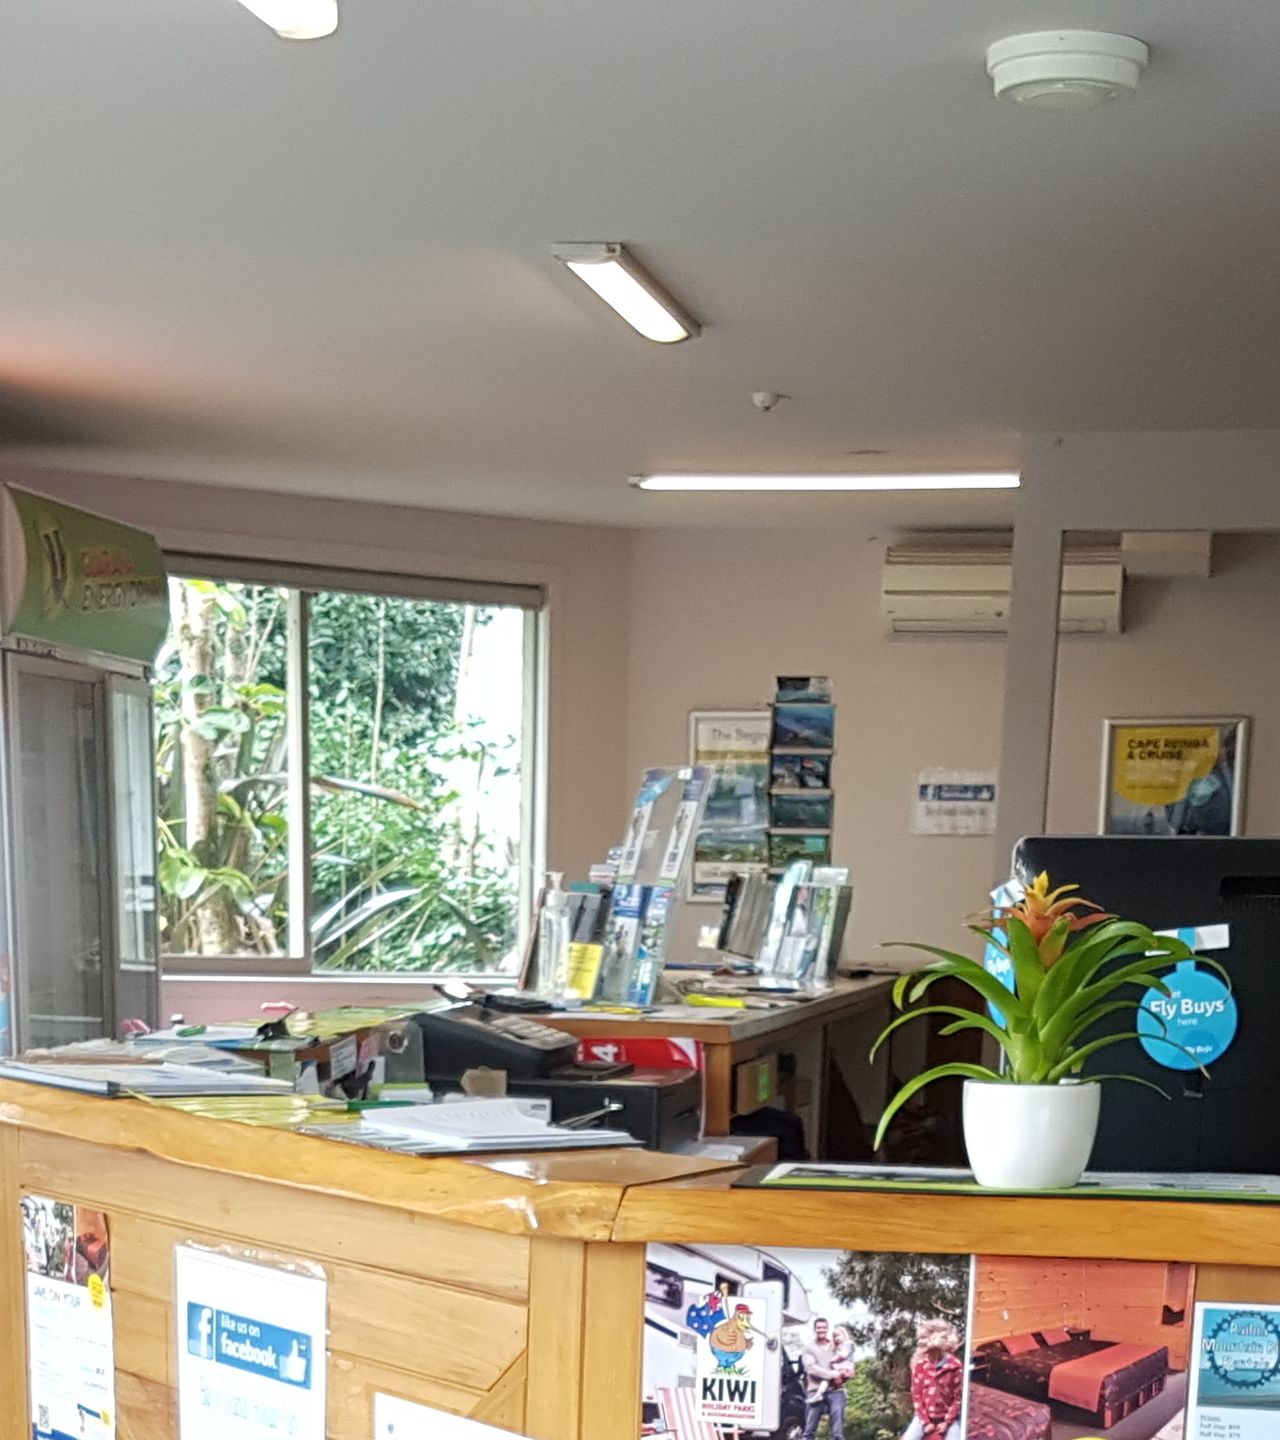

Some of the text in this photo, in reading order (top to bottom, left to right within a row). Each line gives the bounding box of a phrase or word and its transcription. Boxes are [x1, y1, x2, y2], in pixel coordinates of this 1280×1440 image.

[1150, 999, 1224, 1019] Fly Buys
[221, 1314, 261, 1338] like us on
[221, 1332, 278, 1370] facebook
[701, 1378, 757, 1404] KIWI
